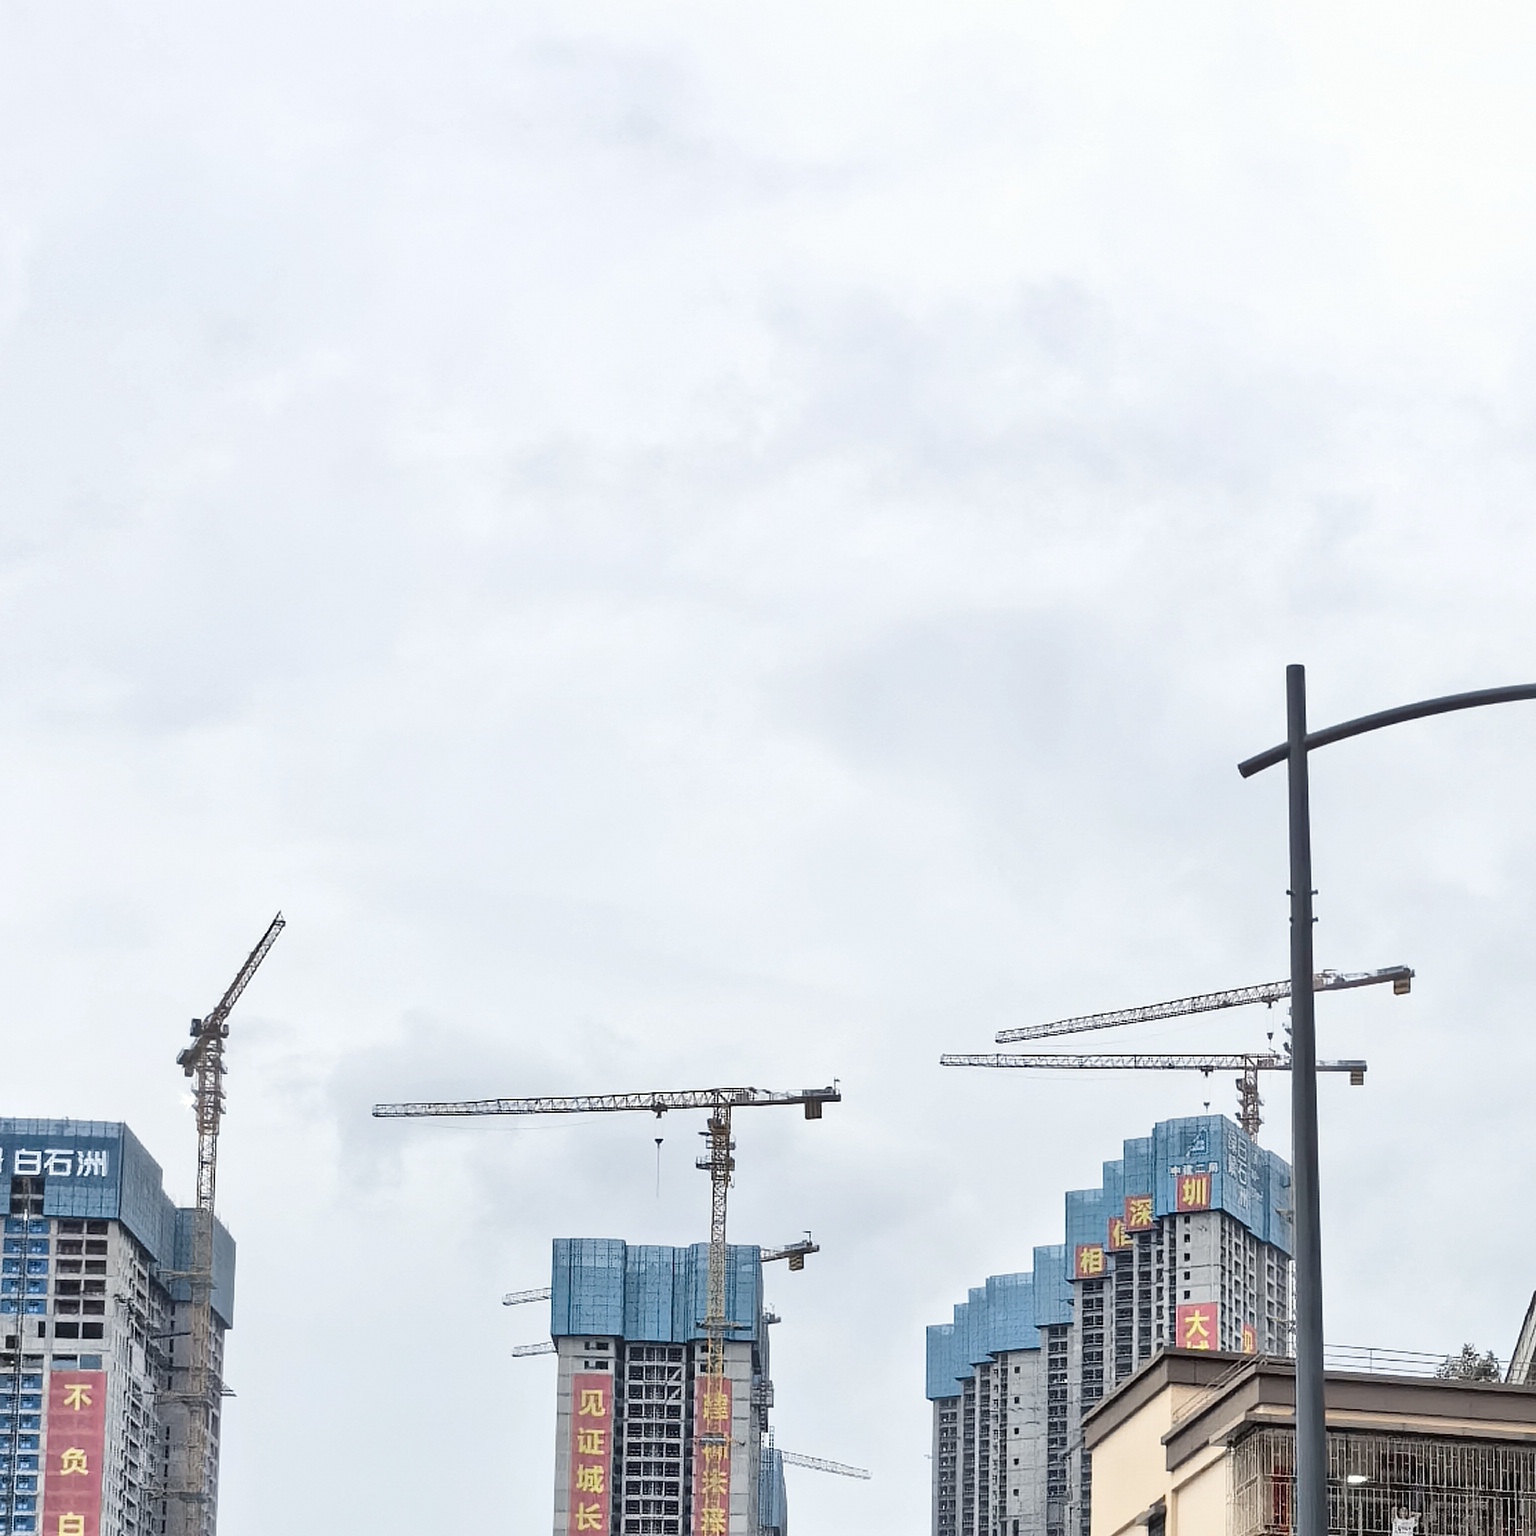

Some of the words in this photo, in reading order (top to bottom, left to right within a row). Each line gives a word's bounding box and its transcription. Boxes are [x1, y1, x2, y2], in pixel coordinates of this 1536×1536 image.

[14, 1148, 109, 1177] 白石洲
[575, 1389, 606, 1532] 见证城长
